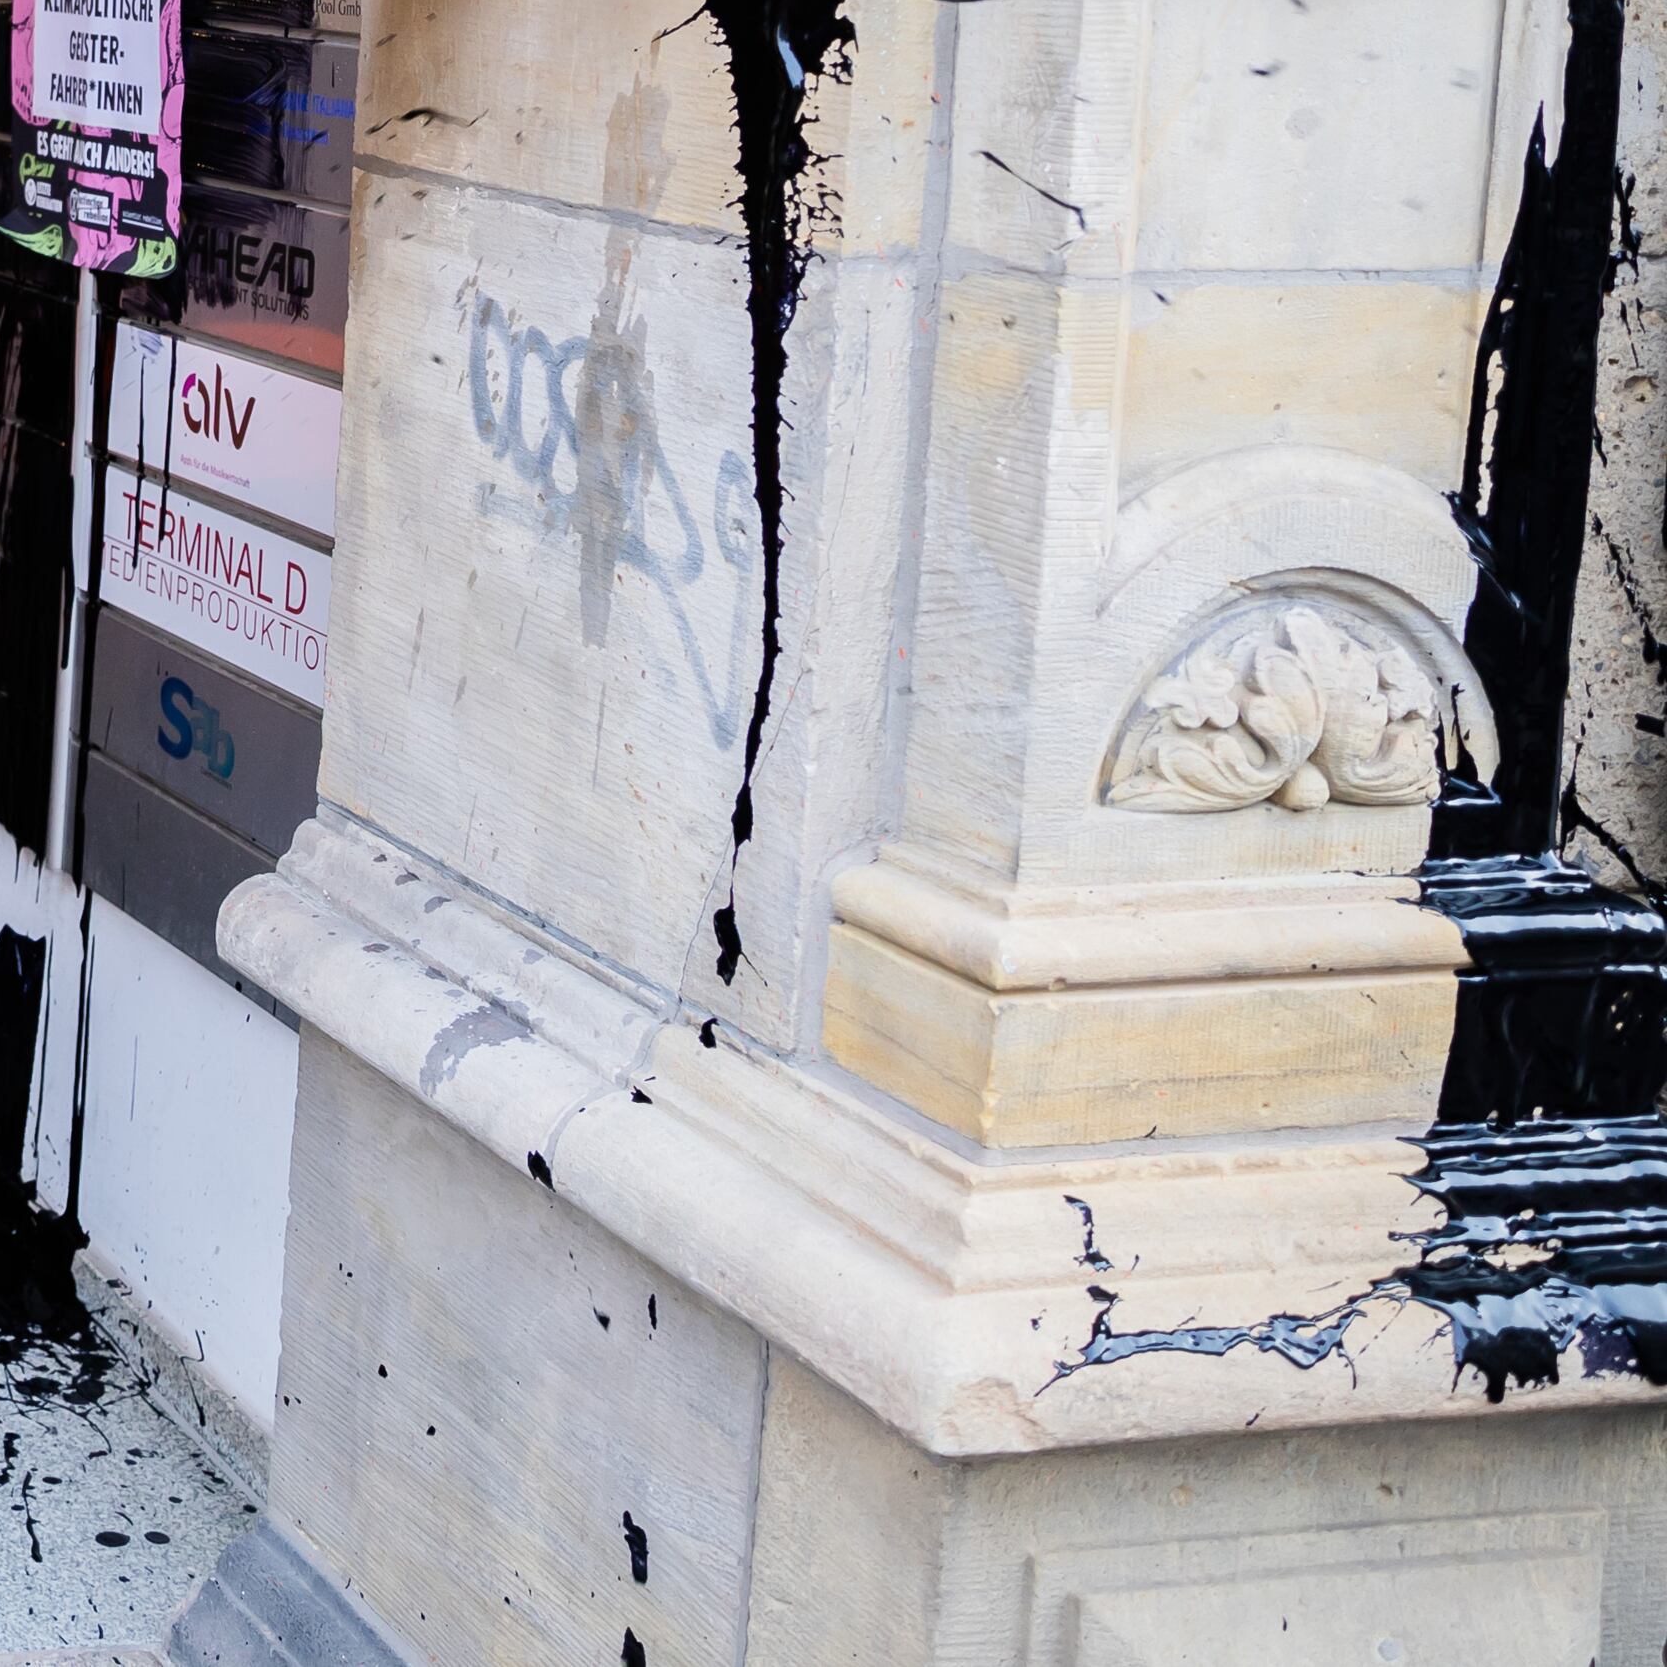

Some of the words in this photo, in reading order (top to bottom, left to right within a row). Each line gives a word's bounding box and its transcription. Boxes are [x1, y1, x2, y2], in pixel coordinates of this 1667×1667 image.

[69, 30, 125, 65] GEISTER-
[36, 131, 49, 157] ES
[50, 133, 74, 162] GEHT
[74, 139, 102, 169] AUCH
[105, 145, 155, 178] ANDERS!
[182, 363, 256, 450] alv
[123, 491, 274, 604] TERMINAL
[285, 561, 308, 615] D
[101, 540, 328, 676] EDIENPRODUKTIO
